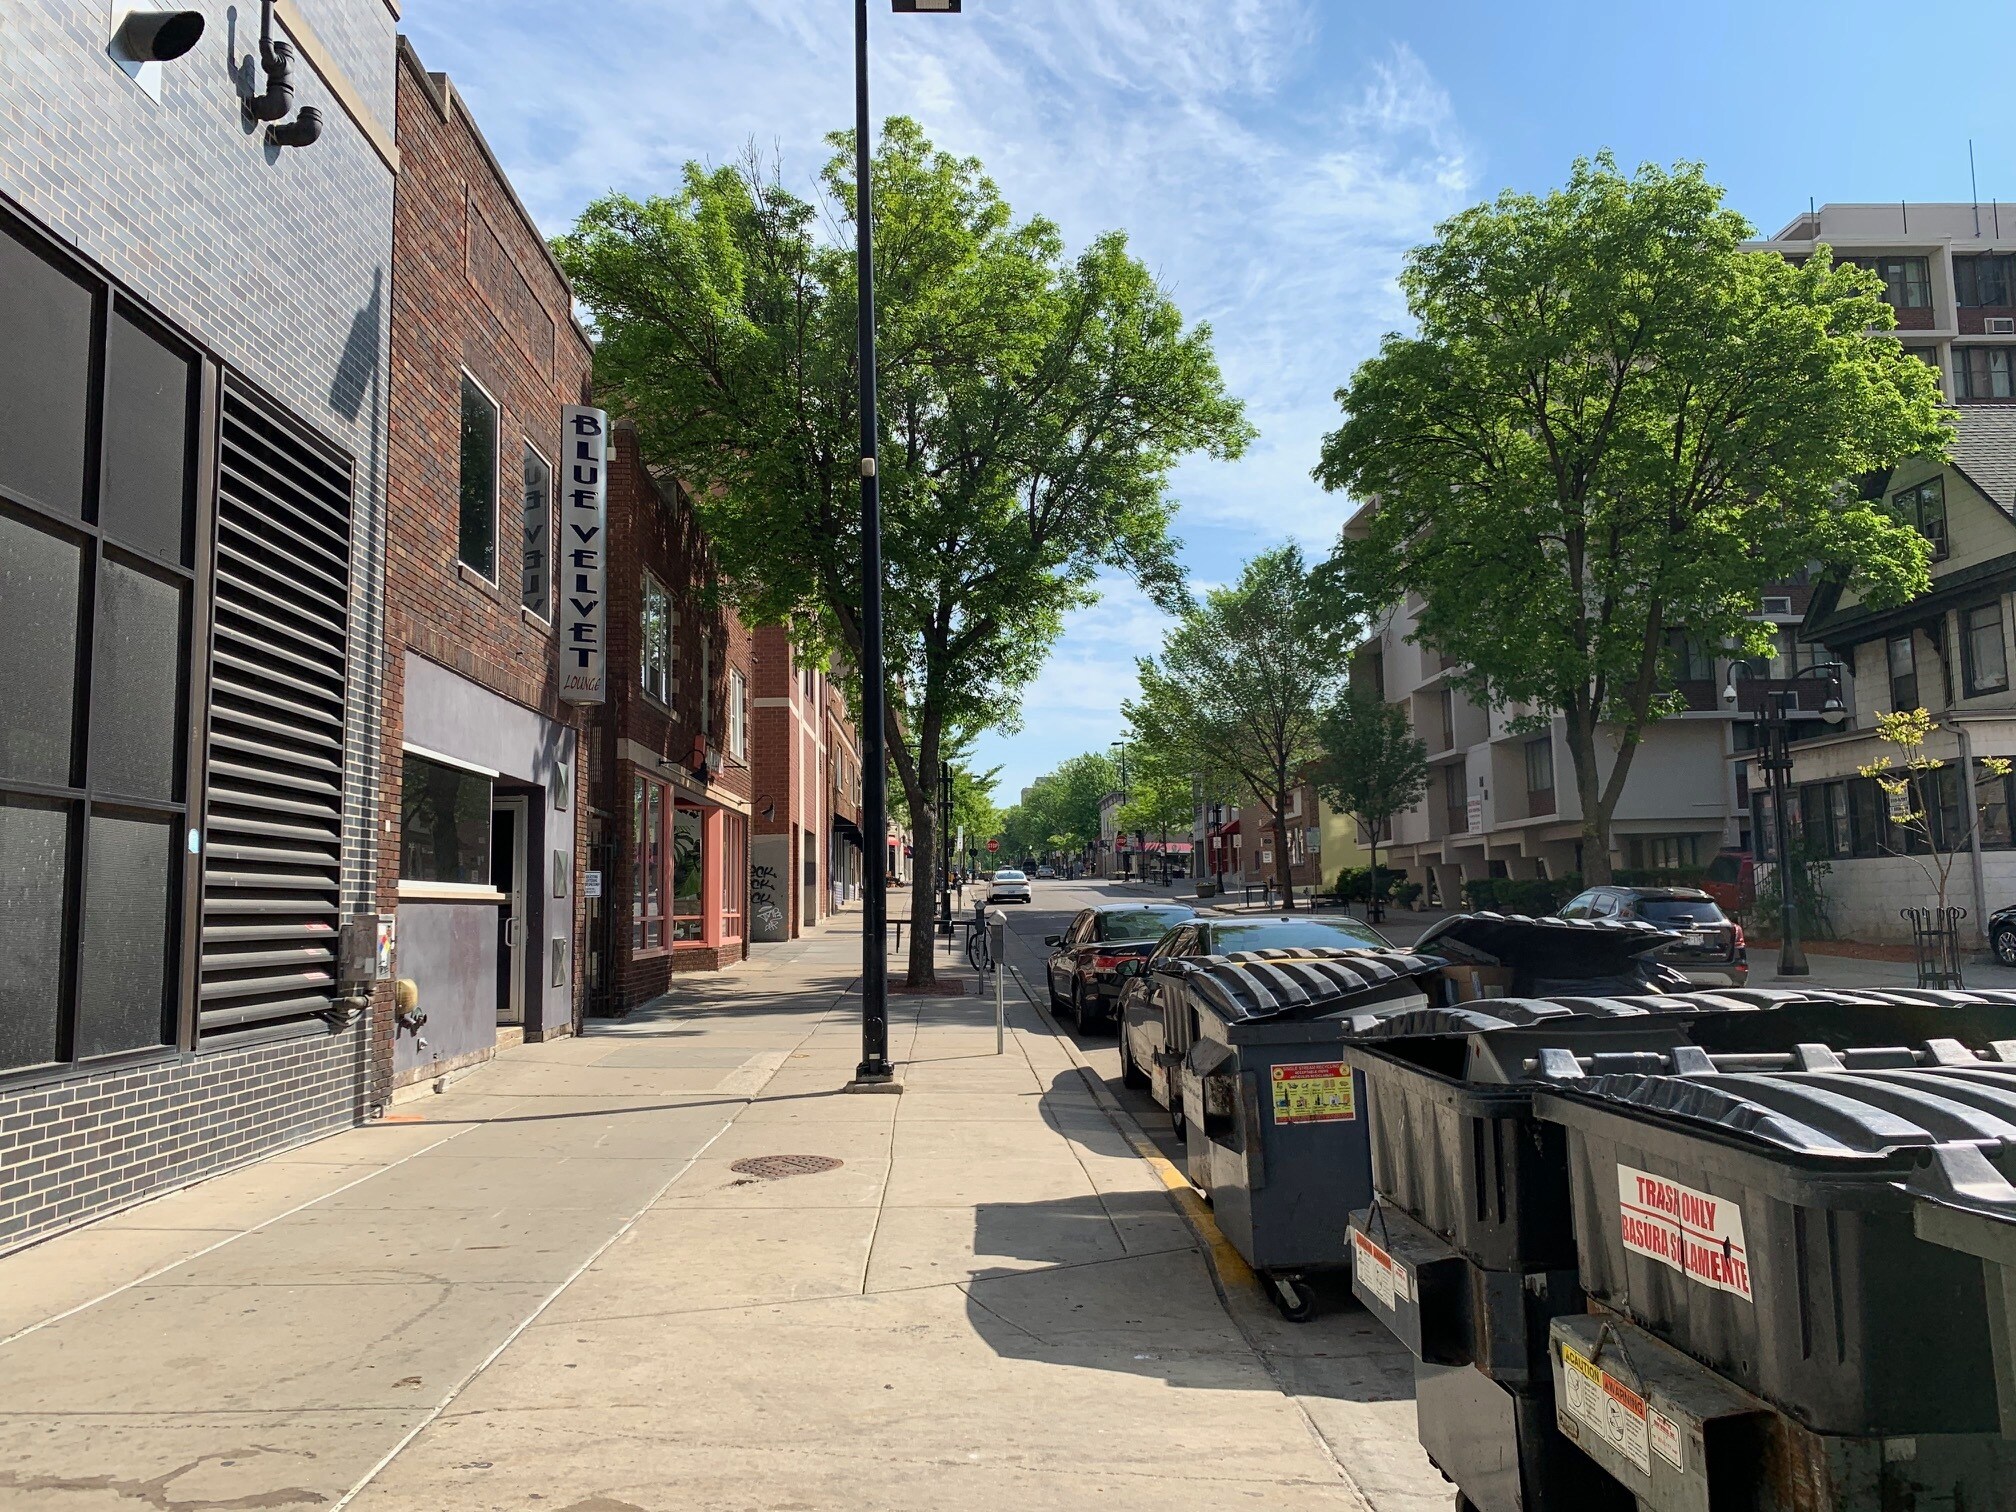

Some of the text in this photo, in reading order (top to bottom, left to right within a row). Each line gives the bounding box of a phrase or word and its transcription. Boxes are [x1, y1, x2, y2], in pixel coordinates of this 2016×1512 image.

[568, 414, 602, 668] BLUE VELVET
[563, 674, 601, 691] LOUNGE
[1636, 1176, 1716, 1231] TRASH ONLY
[1621, 1214, 1669, 1257] BASURA
[1569, 1351, 1600, 1383] CAUTION
[1608, 1382, 1643, 1416] WARNING
